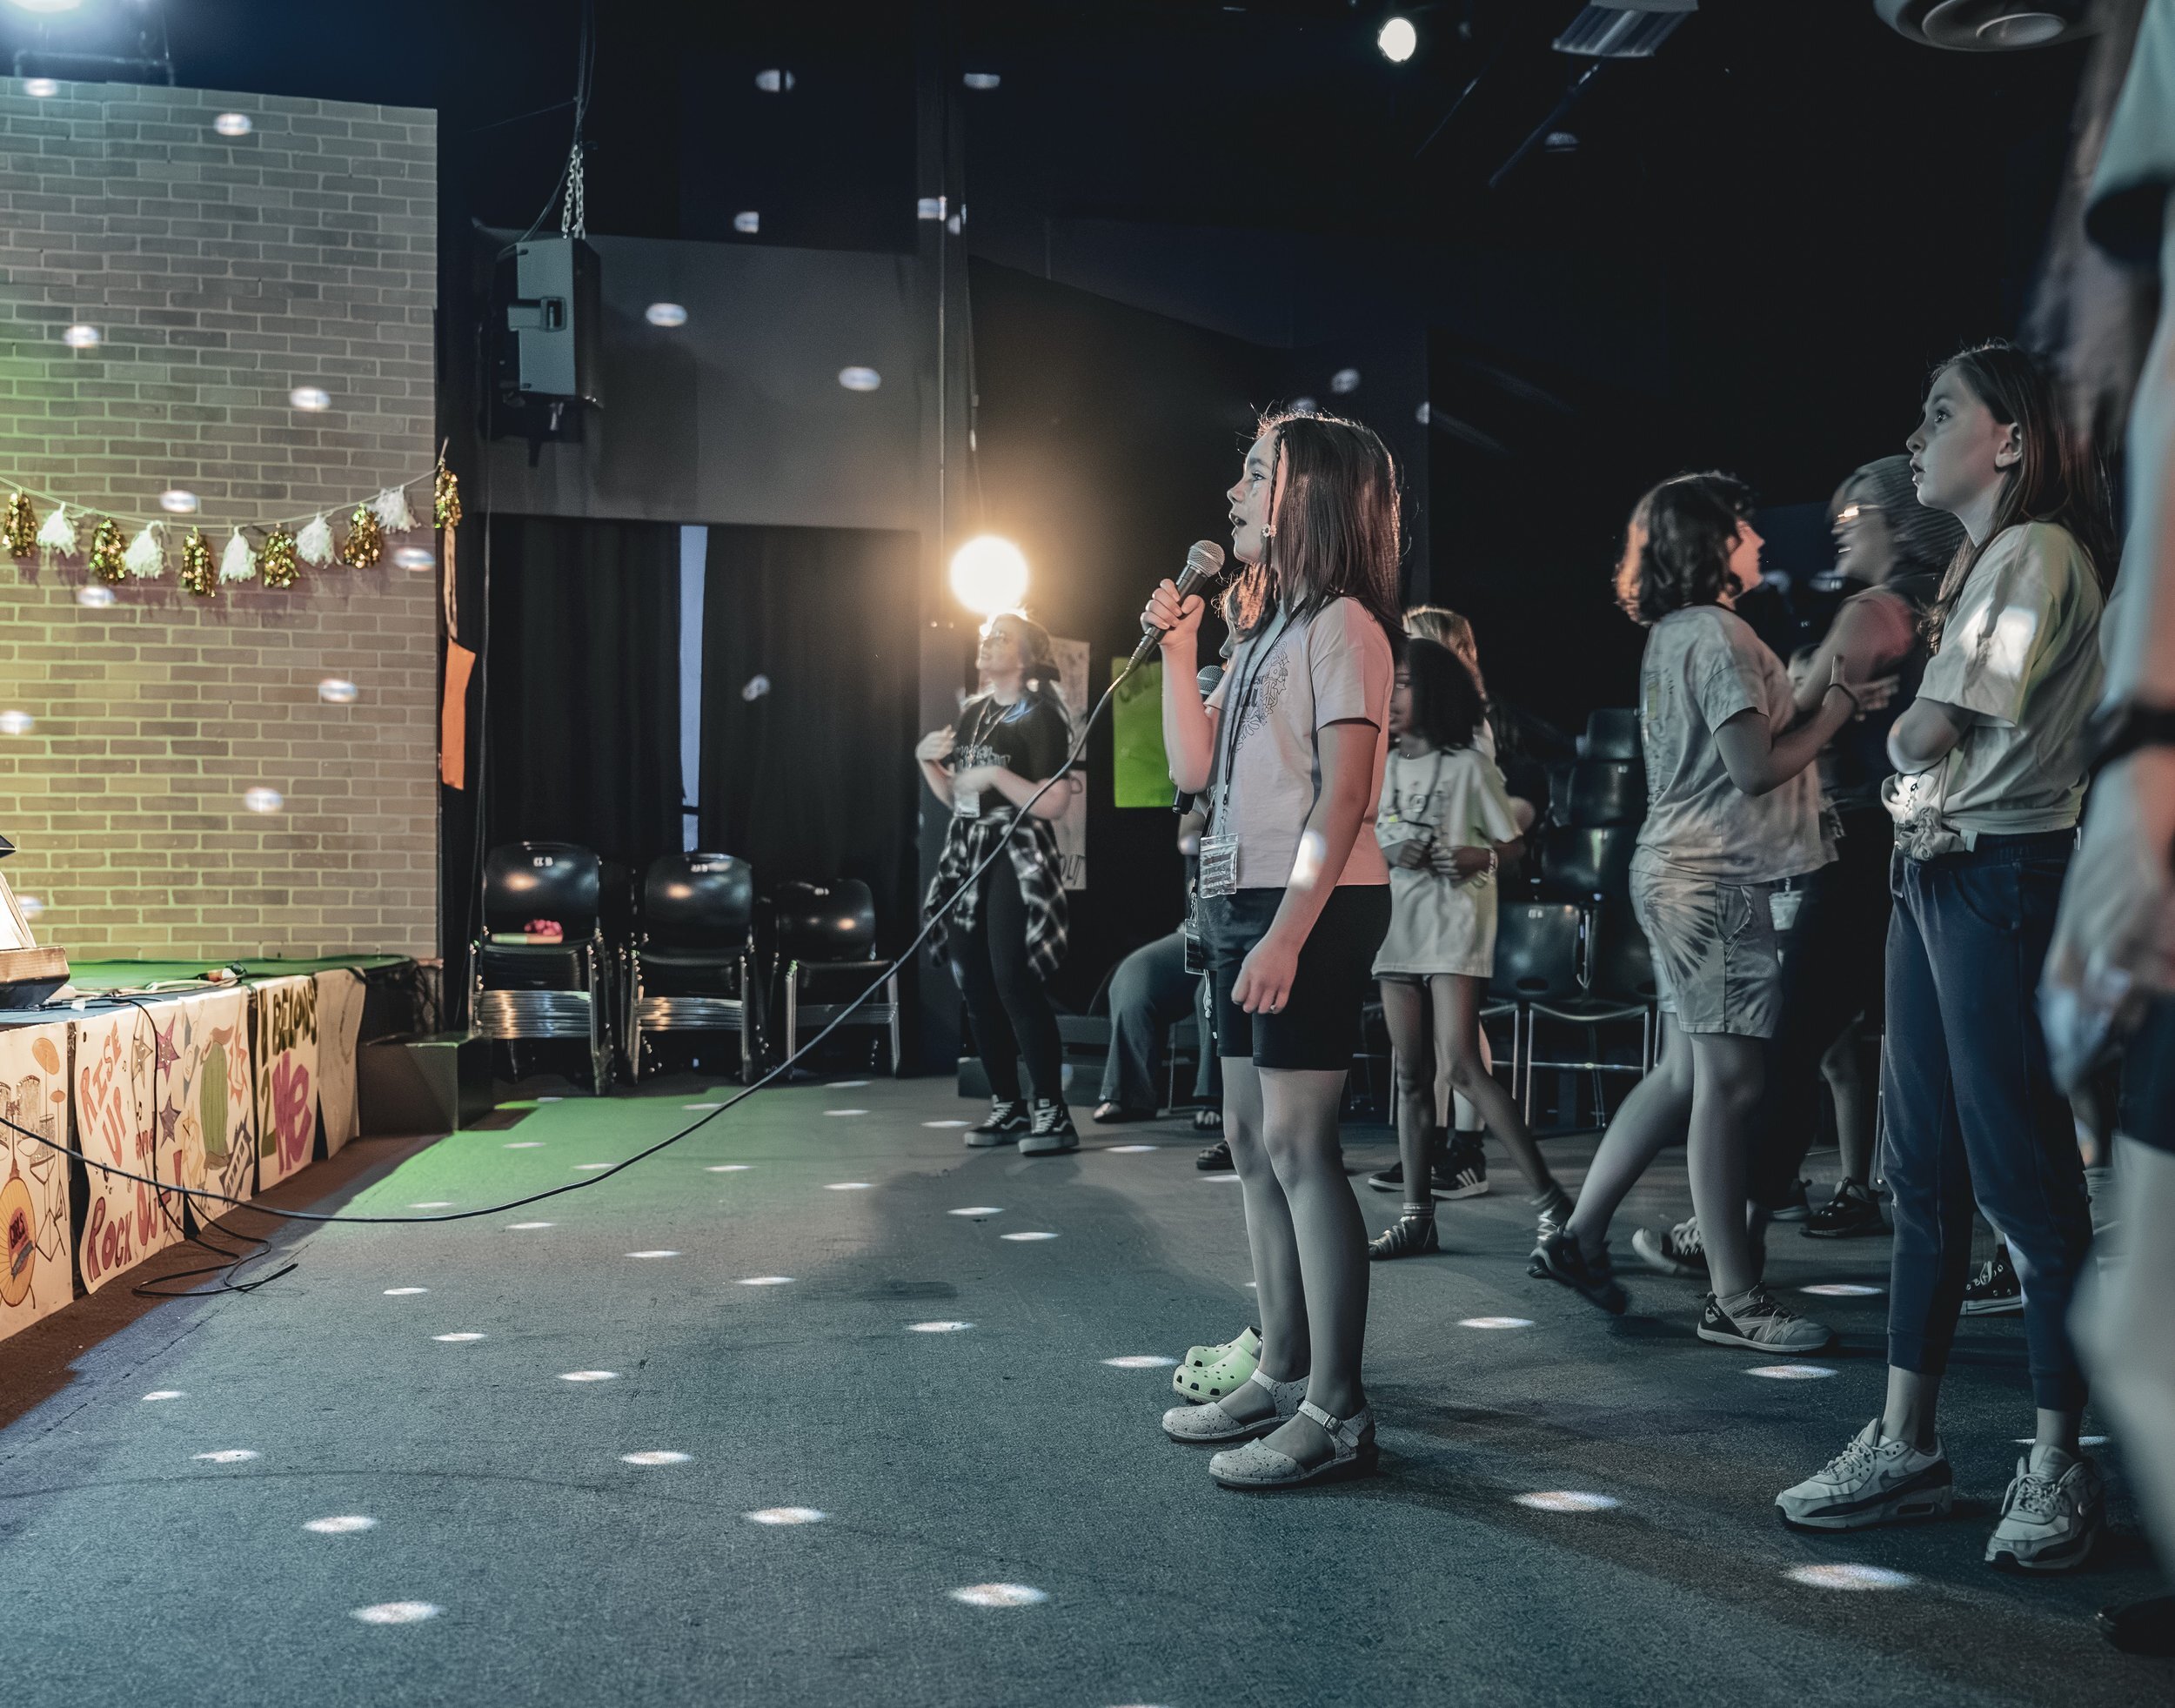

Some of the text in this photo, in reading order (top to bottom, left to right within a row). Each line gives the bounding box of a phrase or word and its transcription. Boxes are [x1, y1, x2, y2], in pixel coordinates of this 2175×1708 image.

[80, 1020, 122, 1136] RISE
[260, 1067, 278, 1159] 2
[102, 1086, 126, 1168] UP
[87, 1196, 132, 1283] ROCK
